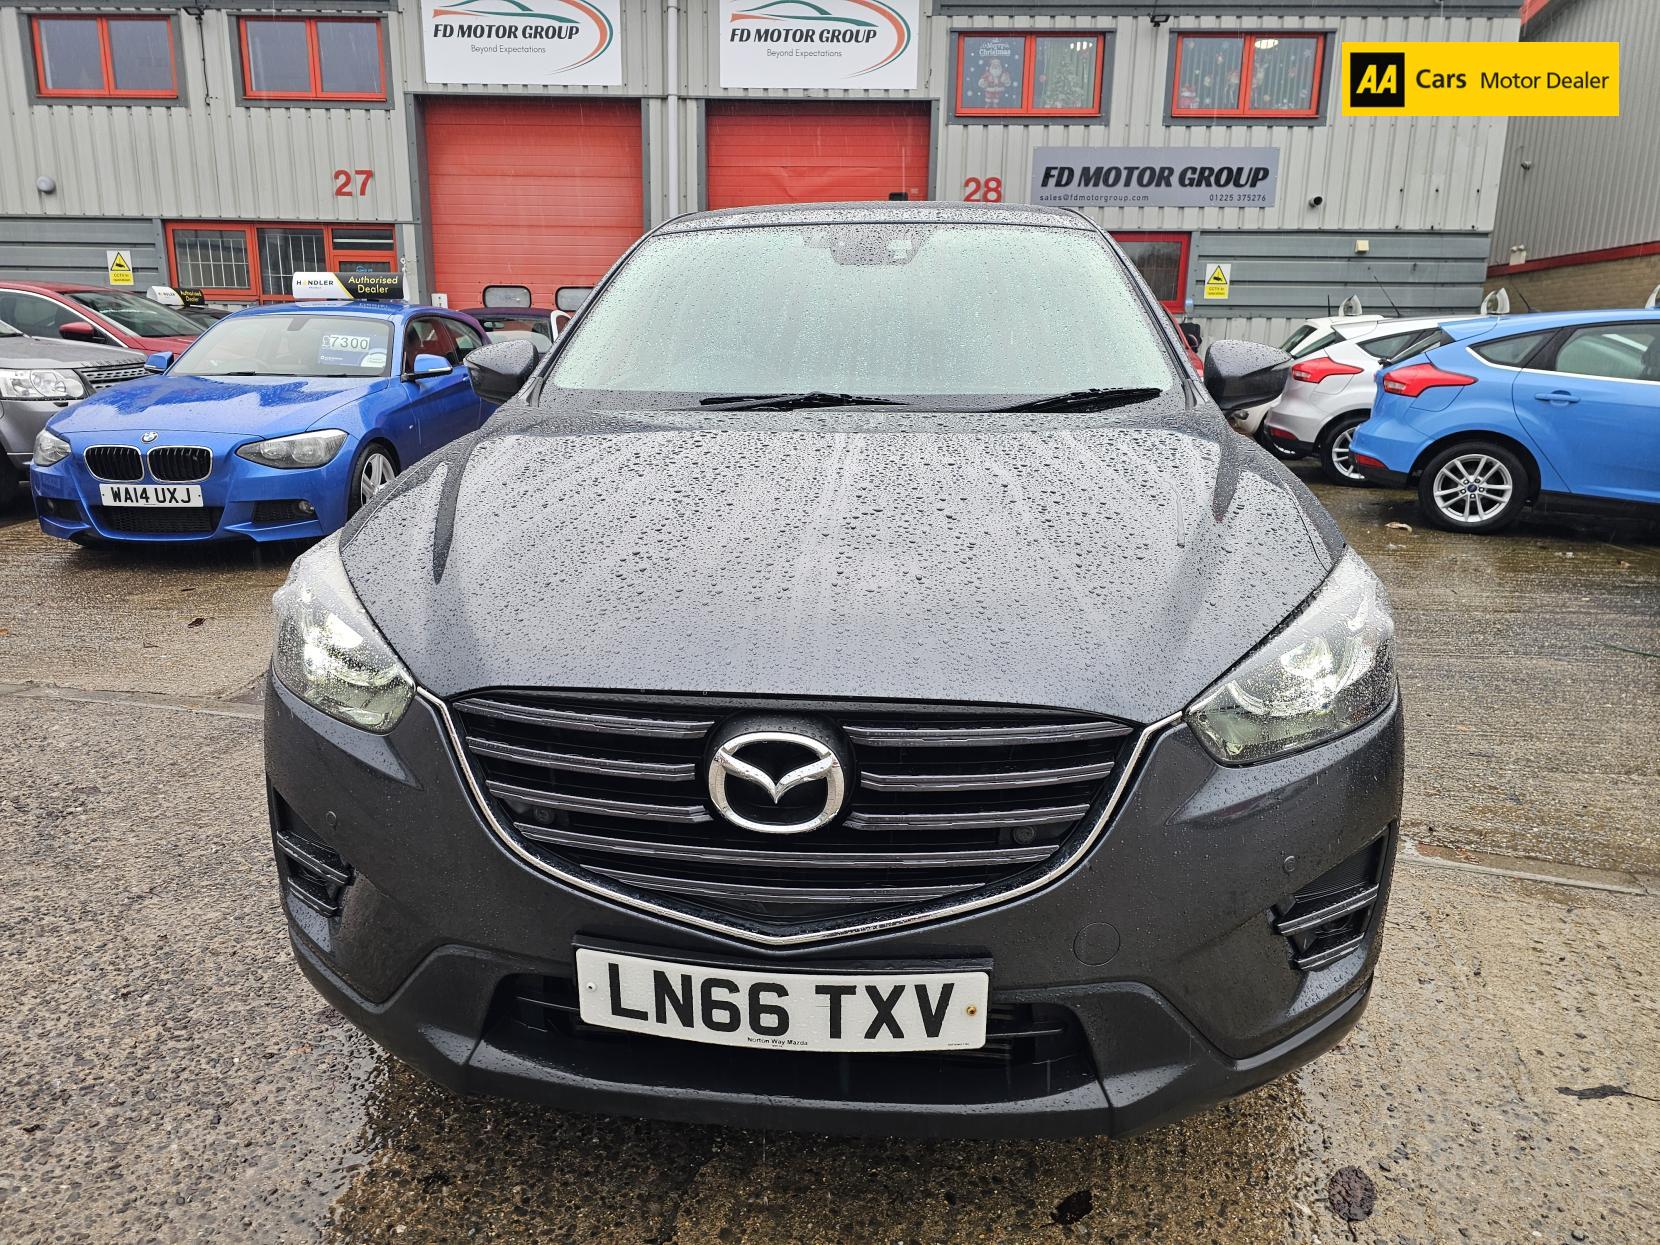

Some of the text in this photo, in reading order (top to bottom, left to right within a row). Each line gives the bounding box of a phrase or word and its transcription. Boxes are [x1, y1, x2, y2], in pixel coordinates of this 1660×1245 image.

[433, 24, 580, 40] FD MOTOR GROUP
[729, 28, 877, 43] FD MOTOR GROUP
[471, 45, 546, 55] Beyond Expectations
[766, 49, 842, 59] Beyond Expectations
[333, 169, 374, 197] 27
[1040, 166, 1270, 188] FD MOTOR GROUP
[963, 176, 1002, 203] 28
[1039, 194, 1149, 202] sales@fdmotorgroup.com
[1209, 194, 1266, 202] 01225 375276
[348, 275, 399, 284] Authorised
[357, 285, 389, 293] Dealer
[110, 486, 191, 504] WA14 UXJ
[607, 962, 955, 1040] LN66 TXV
[771, 1038, 786, 1046] Way
